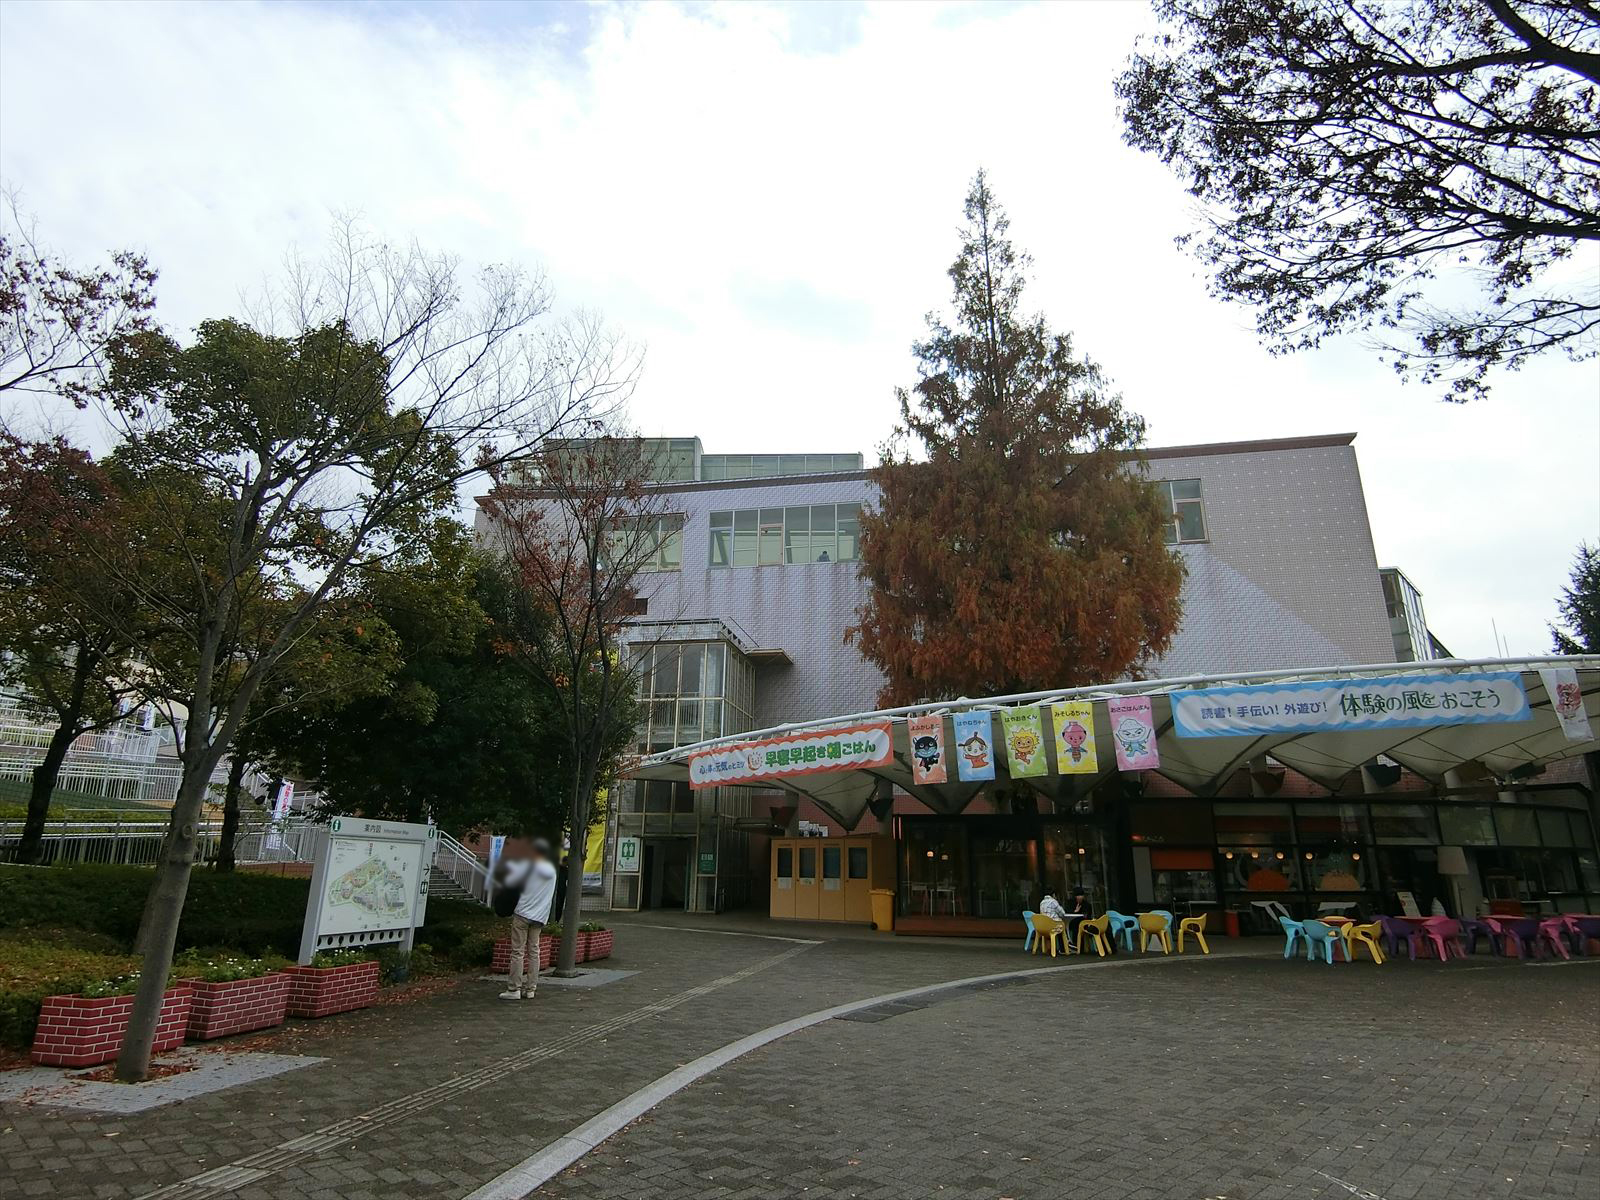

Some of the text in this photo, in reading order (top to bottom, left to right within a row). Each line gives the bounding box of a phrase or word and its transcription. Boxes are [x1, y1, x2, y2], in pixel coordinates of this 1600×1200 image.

[1339, 689, 1500, 717] 体験の風をおこそう
[765, 740, 876, 767] 早寝早起き朝ごはん
